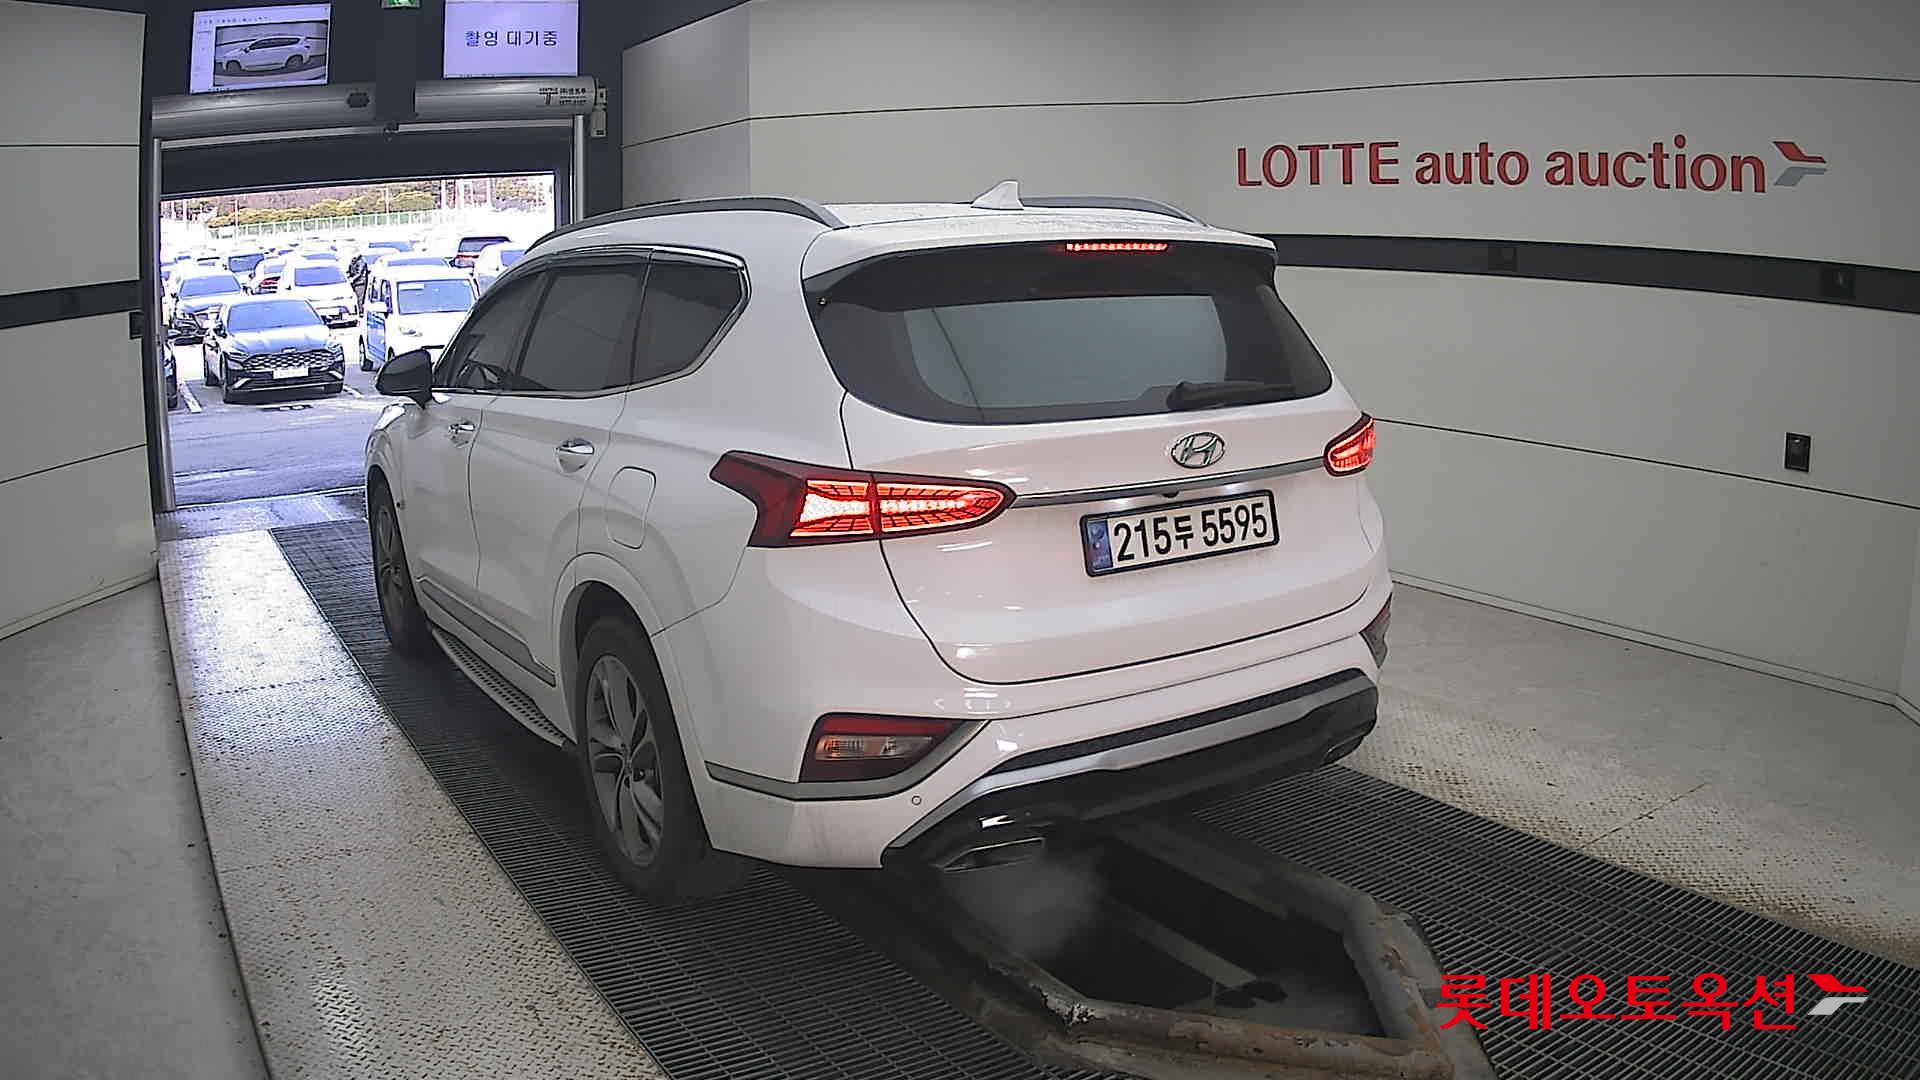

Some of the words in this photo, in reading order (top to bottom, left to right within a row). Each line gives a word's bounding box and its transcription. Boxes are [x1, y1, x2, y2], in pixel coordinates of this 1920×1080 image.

[464, 30, 498, 47] 촬영
[506, 30, 559, 47] 대기중
[1237, 141, 1400, 188] LOTTE
[1415, 142, 1529, 186] auto
[1545, 134, 1767, 193] auction
[1113, 515, 1195, 562] 215두
[1201, 502, 1268, 546] 5595
